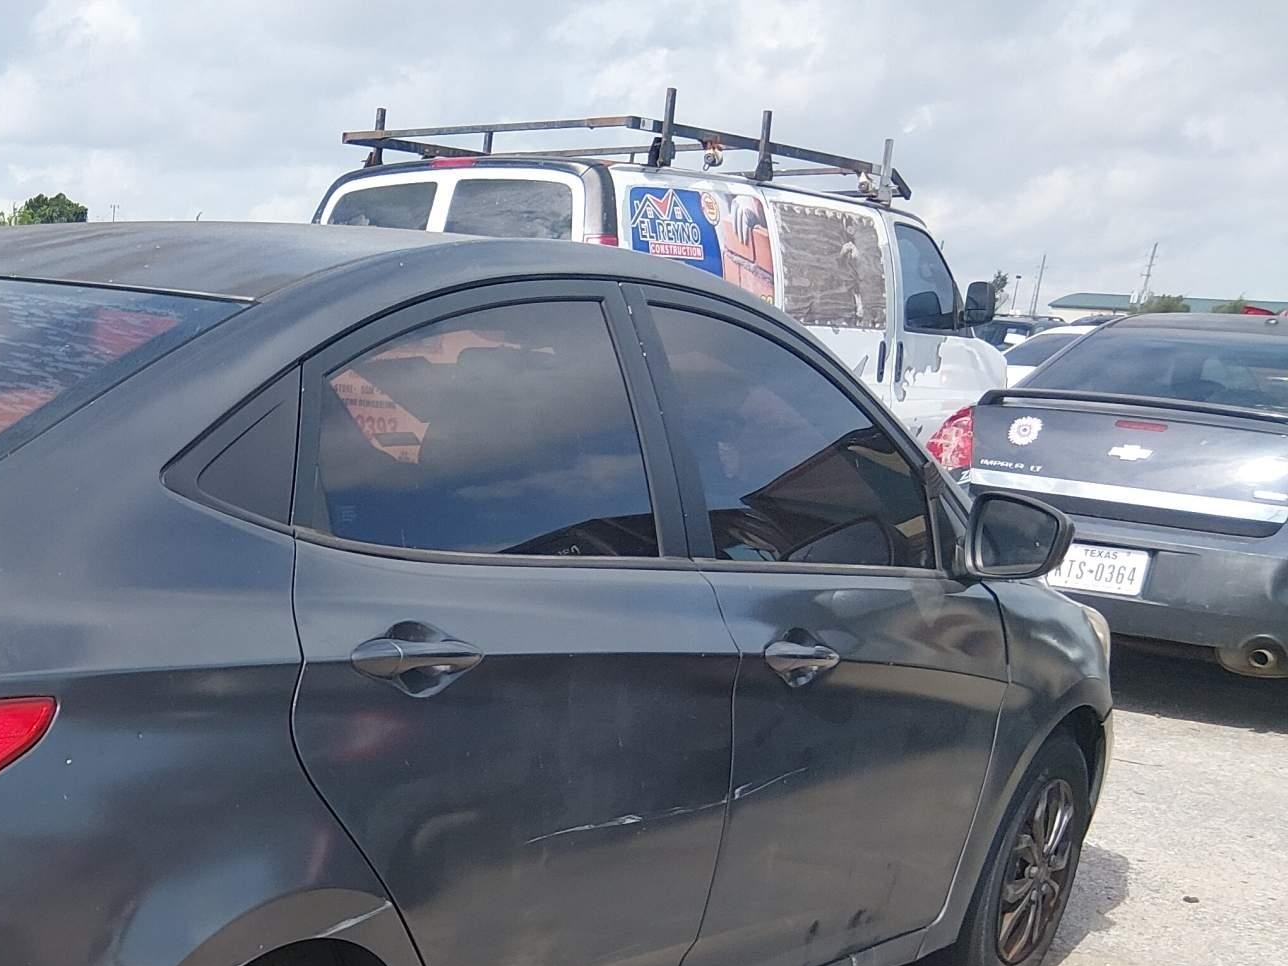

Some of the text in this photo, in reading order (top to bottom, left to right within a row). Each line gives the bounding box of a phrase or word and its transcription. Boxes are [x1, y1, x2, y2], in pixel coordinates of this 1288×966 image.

[638, 217, 701, 245] EL REYNO
[650, 243, 702, 258] CONSTRUCTION
[979, 458, 1025, 470] IMPALA
[1083, 548, 1118, 560] TEXAS
